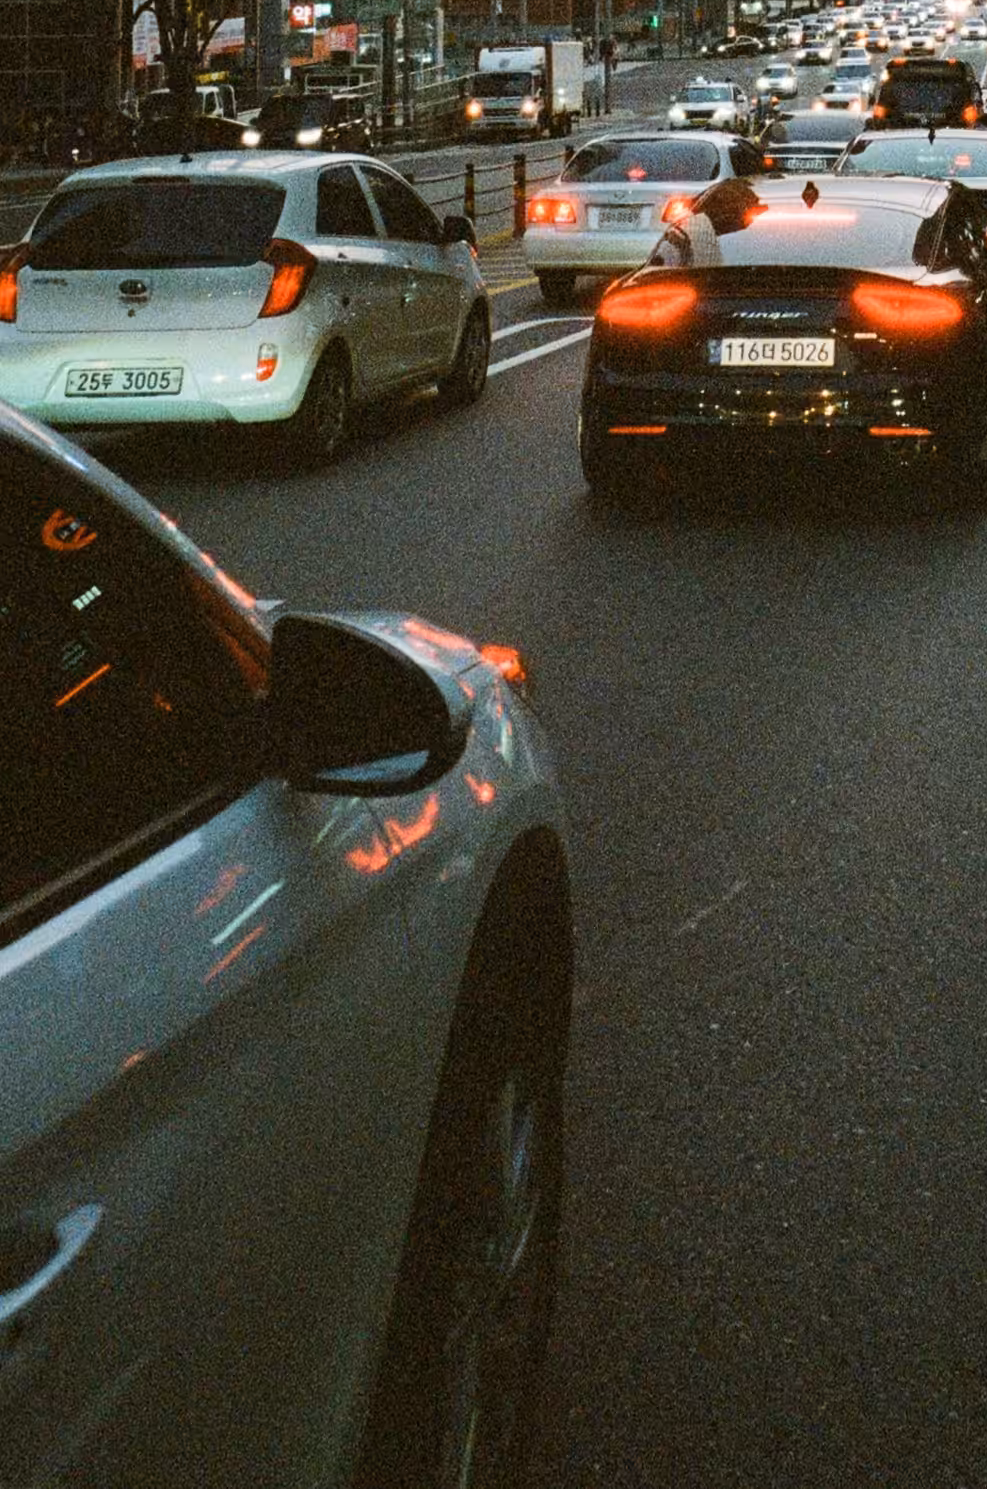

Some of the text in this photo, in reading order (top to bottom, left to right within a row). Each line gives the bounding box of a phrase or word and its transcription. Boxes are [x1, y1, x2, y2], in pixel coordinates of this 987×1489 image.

[725, 342, 829, 362] 116더 5026
[77, 371, 171, 391] 25두 3005
